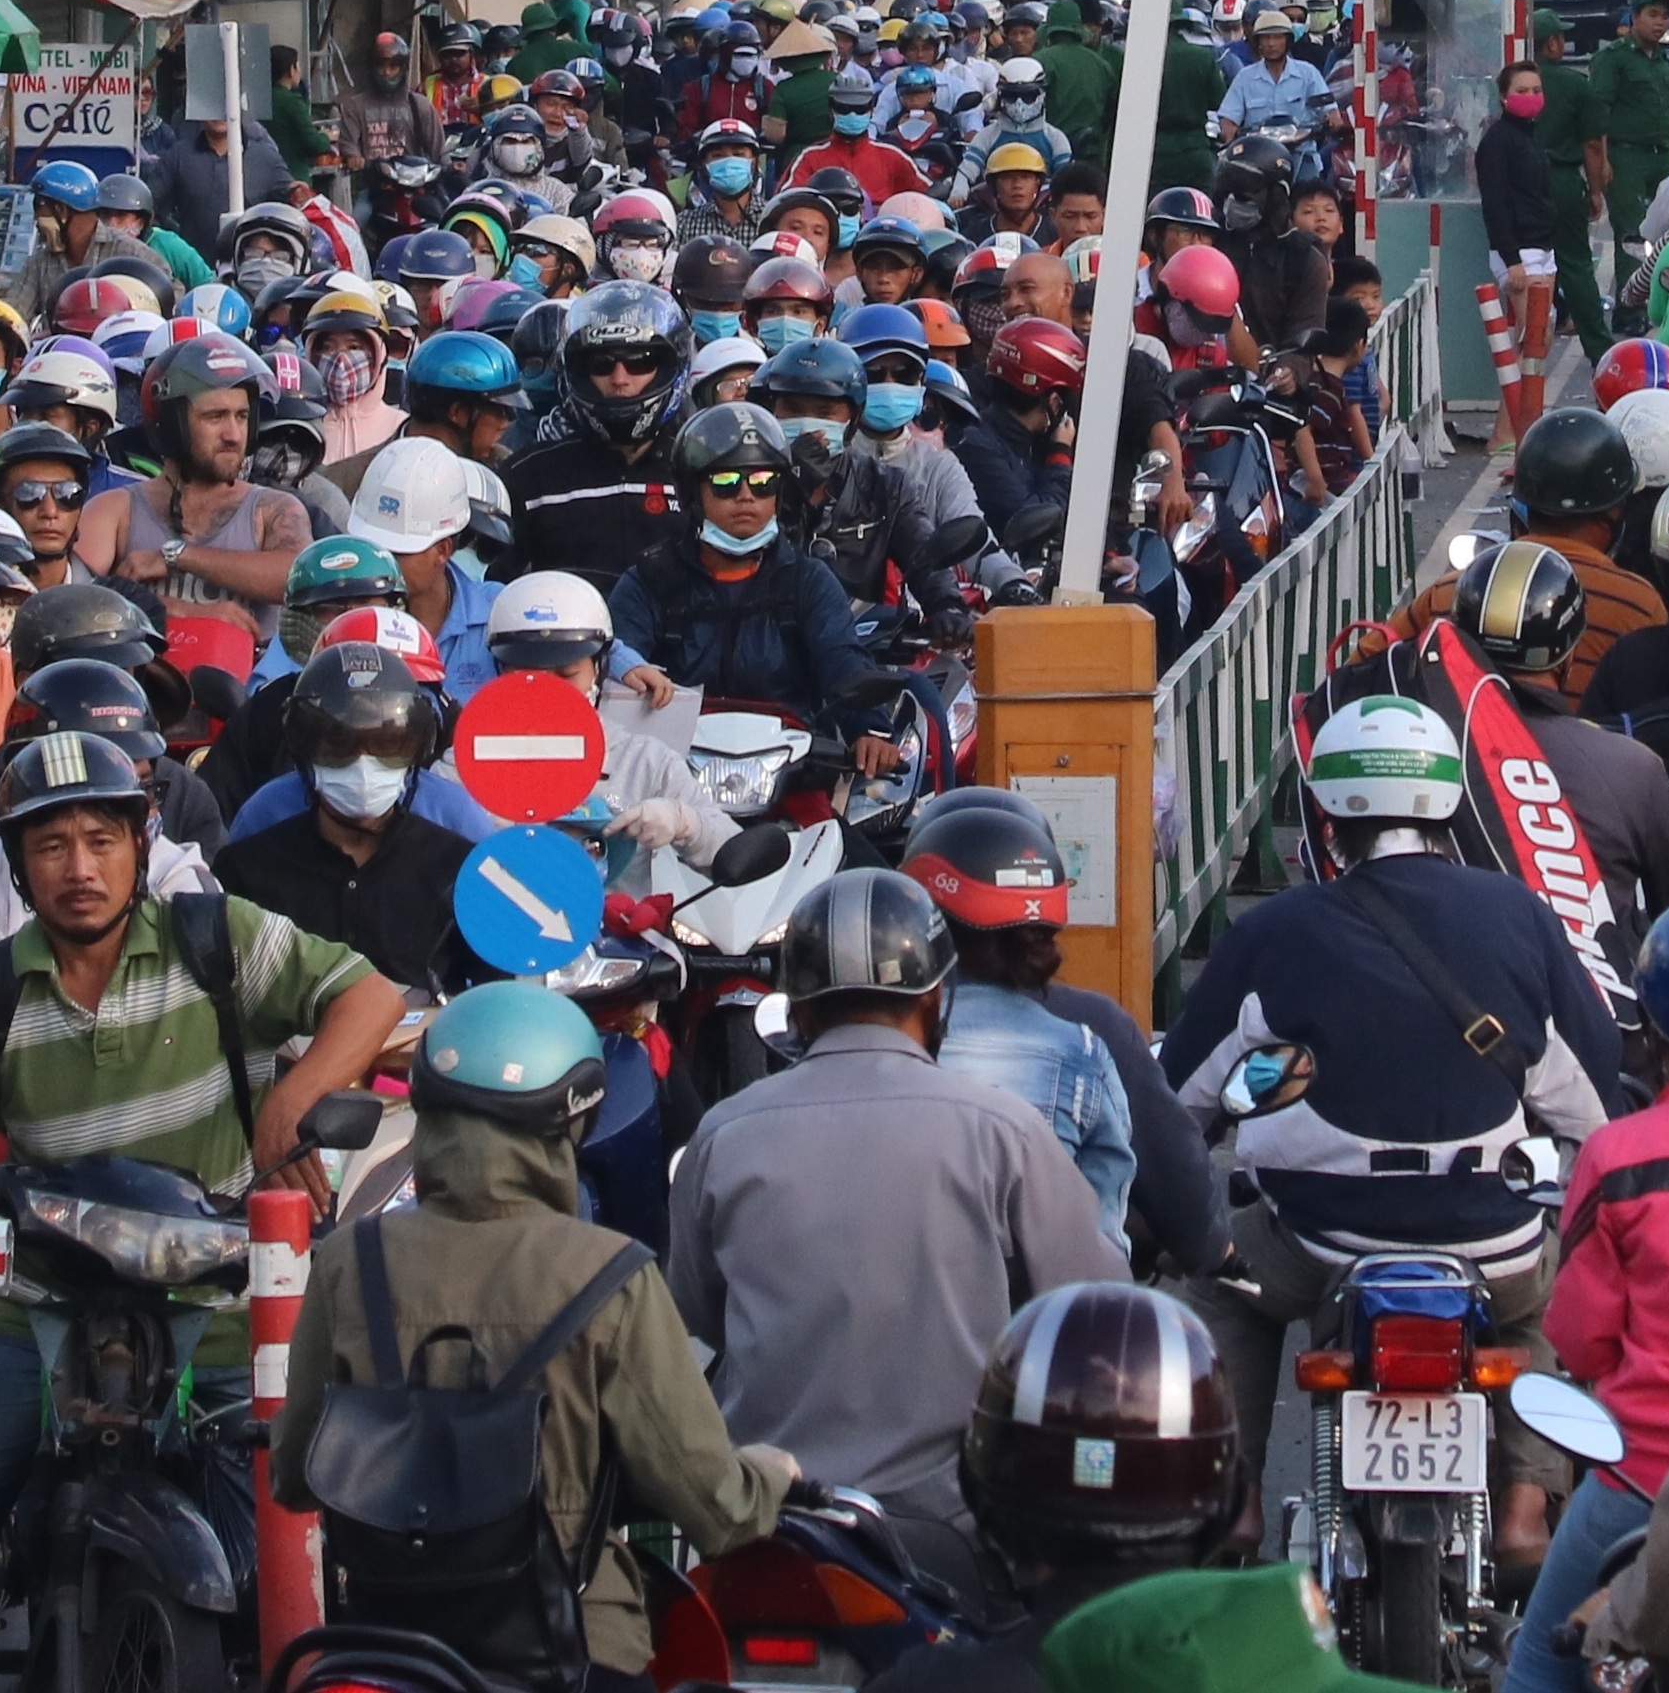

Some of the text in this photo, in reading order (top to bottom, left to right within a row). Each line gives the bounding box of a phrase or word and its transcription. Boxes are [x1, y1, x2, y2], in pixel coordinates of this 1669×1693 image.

[595, 323, 632, 337] HJC
[1365, 1400, 1464, 1440] 72-L3
[1364, 1443, 1464, 1483] 2652
